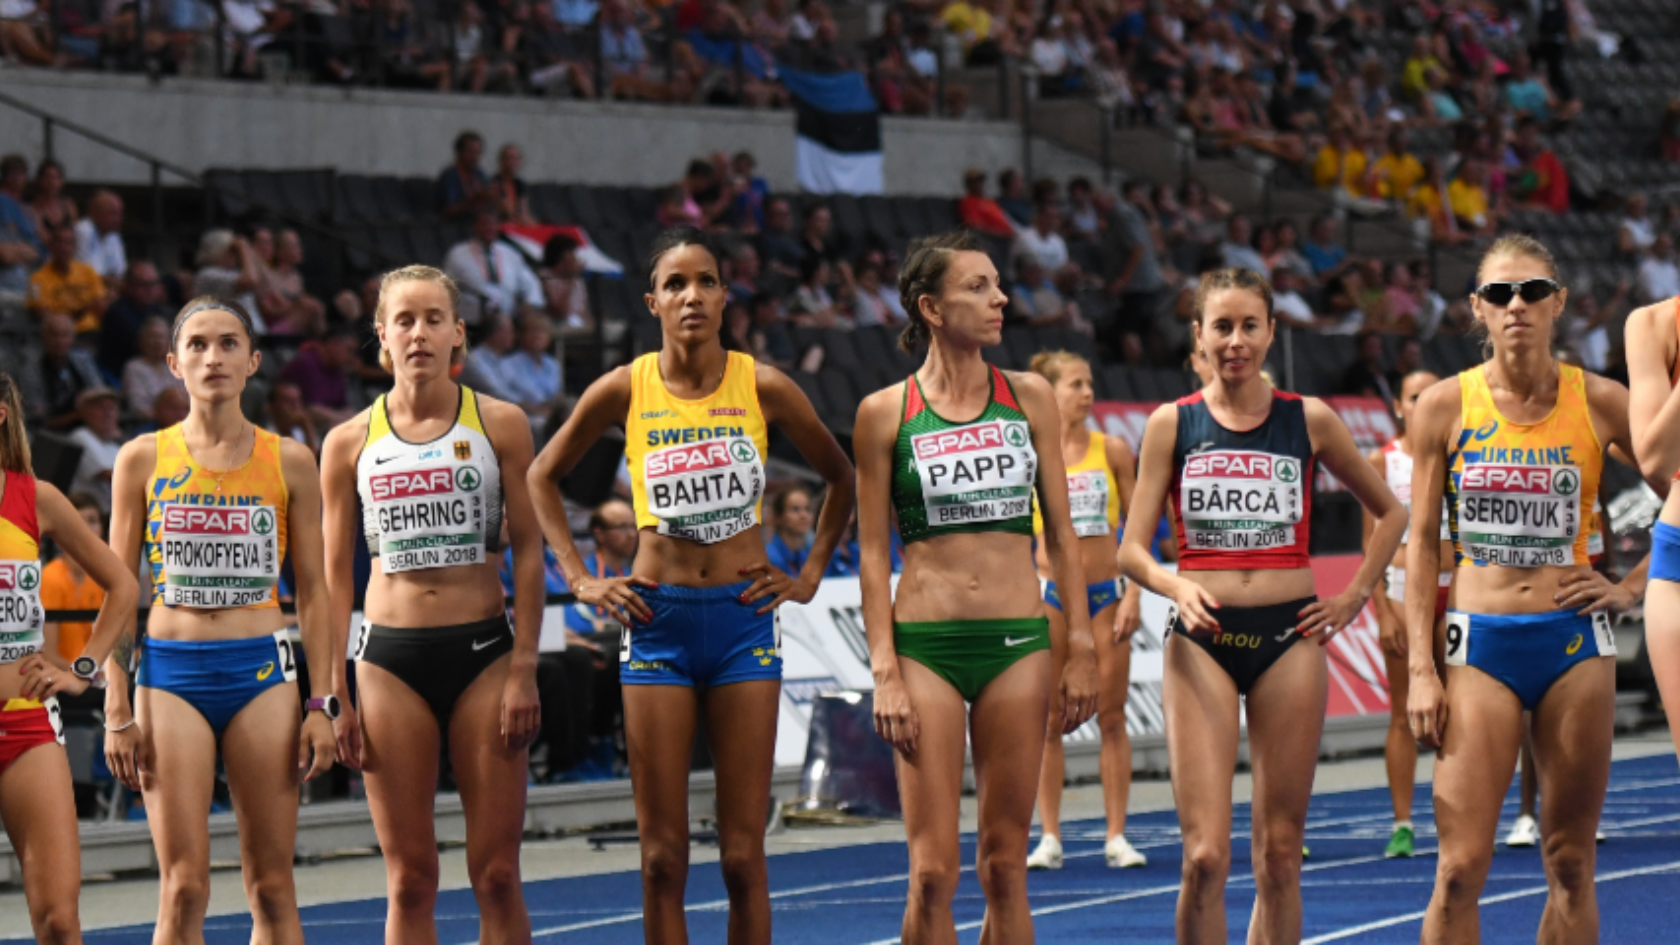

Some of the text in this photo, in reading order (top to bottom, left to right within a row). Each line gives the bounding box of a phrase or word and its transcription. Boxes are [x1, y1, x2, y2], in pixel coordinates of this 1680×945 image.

[646, 426, 744, 446] SWEDEN
[918, 427, 1000, 457] SPAR
[648, 445, 728, 475] SPAR
[1188, 456, 1270, 476] SPAR
[1481, 446, 1575, 465] UKRAINE
[928, 454, 1015, 487] PAPP
[1466, 469, 1549, 490] SPAR
[372, 471, 451, 497] SPAR
[653, 472, 746, 509] BAHTA
[166, 509, 247, 532] SPAR
[379, 499, 466, 533] GEHRING
[939, 503, 995, 522] BERLIN
[1464, 497, 1559, 528] SERDYUK
[1195, 530, 1286, 548] BERLIN 2018
[166, 541, 260, 569] PROKOFYEVA
[389, 547, 477, 570] BERLIN 2018
[1472, 547, 1565, 566] BERLIN 2018
[174, 588, 226, 605] BERLIN
[1447, 623, 1462, 657] 9
